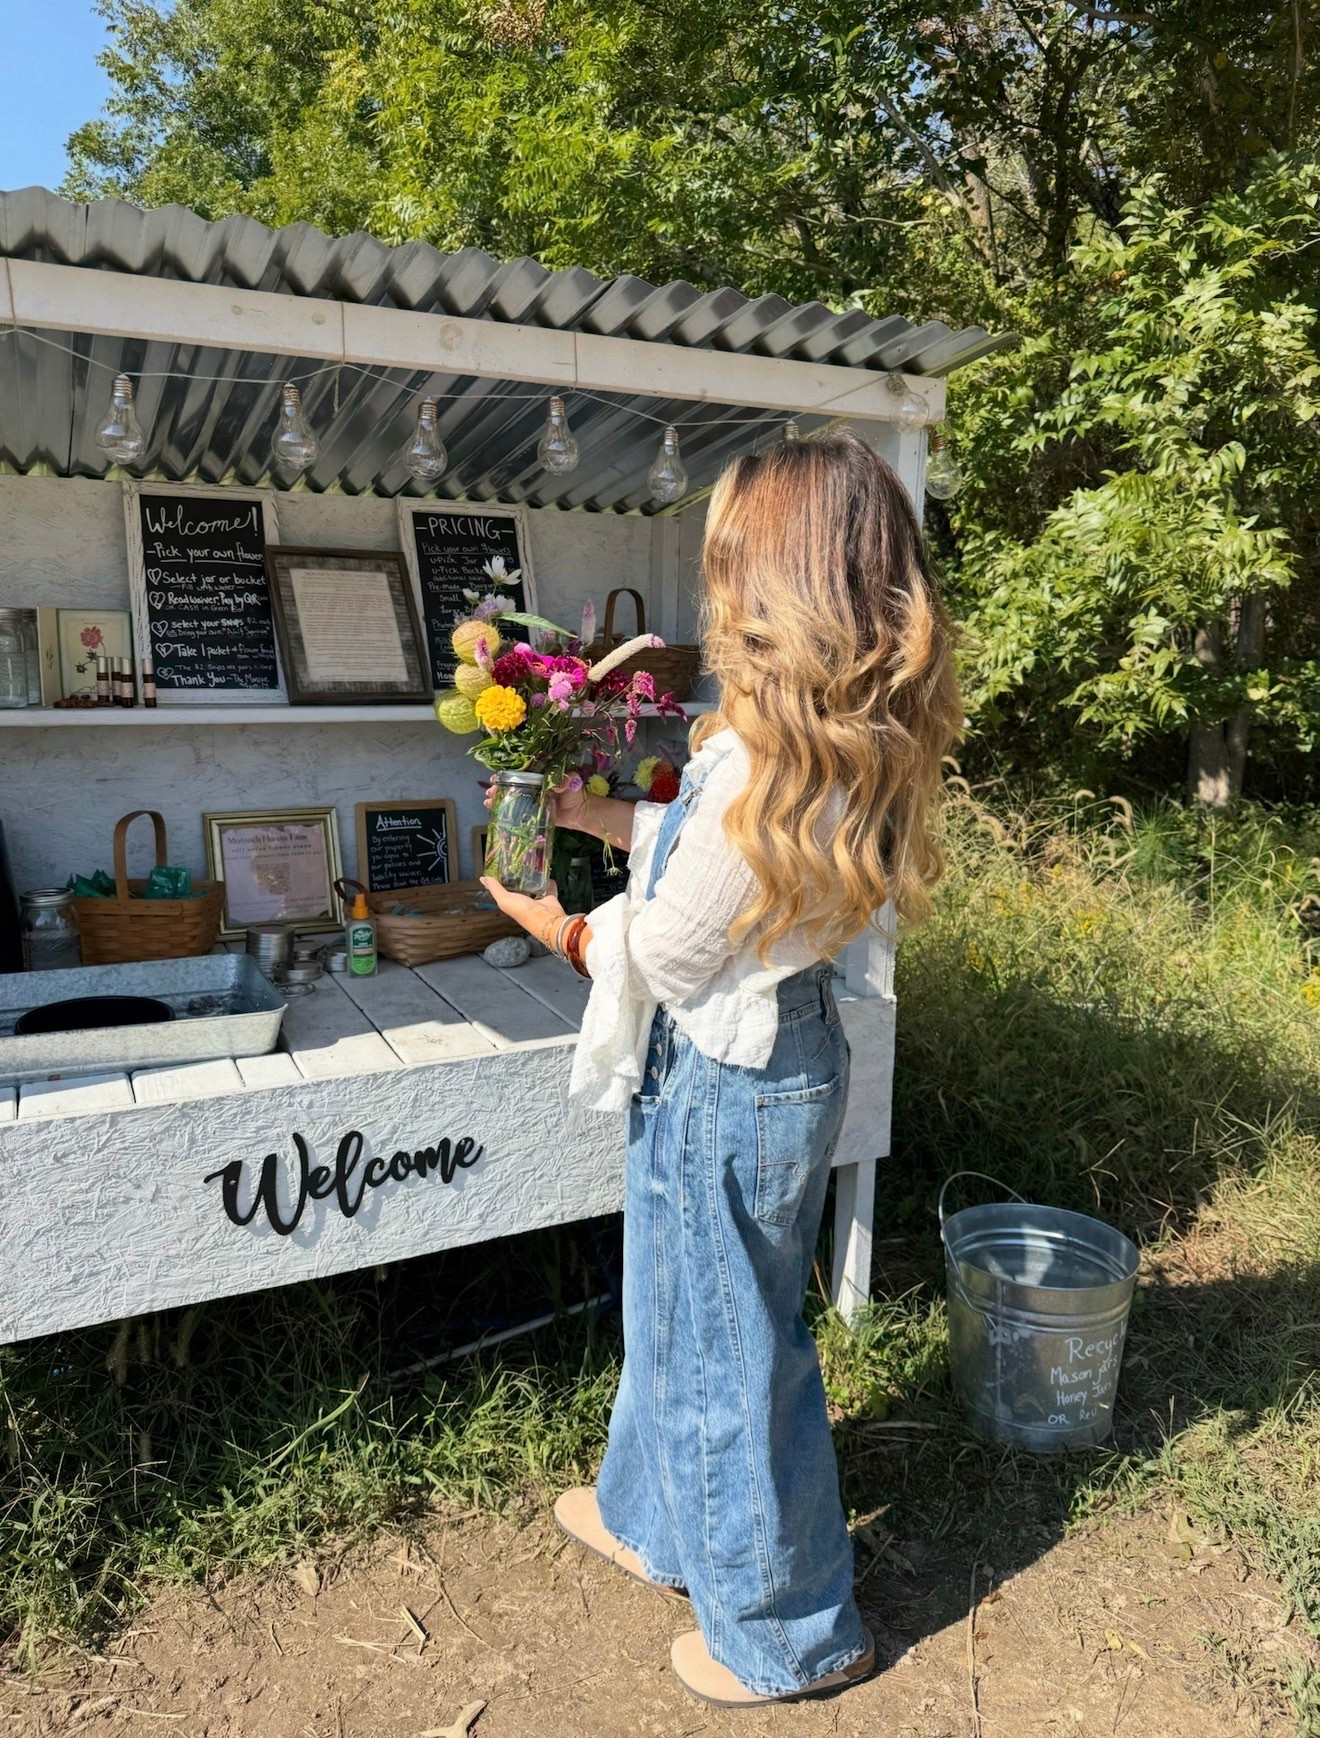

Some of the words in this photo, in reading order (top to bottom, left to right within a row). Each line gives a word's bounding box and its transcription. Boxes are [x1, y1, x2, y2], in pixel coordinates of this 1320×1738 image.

[145, 504, 258, 536] Welcome!
[421, 542, 441, 552] Pick
[187, 548, 210, 563] your
[213, 550, 235, 560] own
[461, 556, 478, 564] Jar
[162, 572, 197, 584] Select
[201, 574, 216, 587] jar
[233, 573, 267, 586] bucket
[167, 592, 193, 604] Read
[219, 592, 234, 610] Pay
[244, 592, 262, 606] QR
[200, 621, 219, 631] your
[174, 643, 198, 657] Take
[207, 644, 231, 659] packet
[171, 675, 205, 687] Thank
[207, 672, 226, 687] You
[376, 814, 422, 829] Attention
[203, 1130, 484, 1236] Welcome
[1050, 1366, 1092, 1386] Mason
[1056, 1389, 1088, 1407] Honey
[1047, 1413, 1070, 1425] OR
